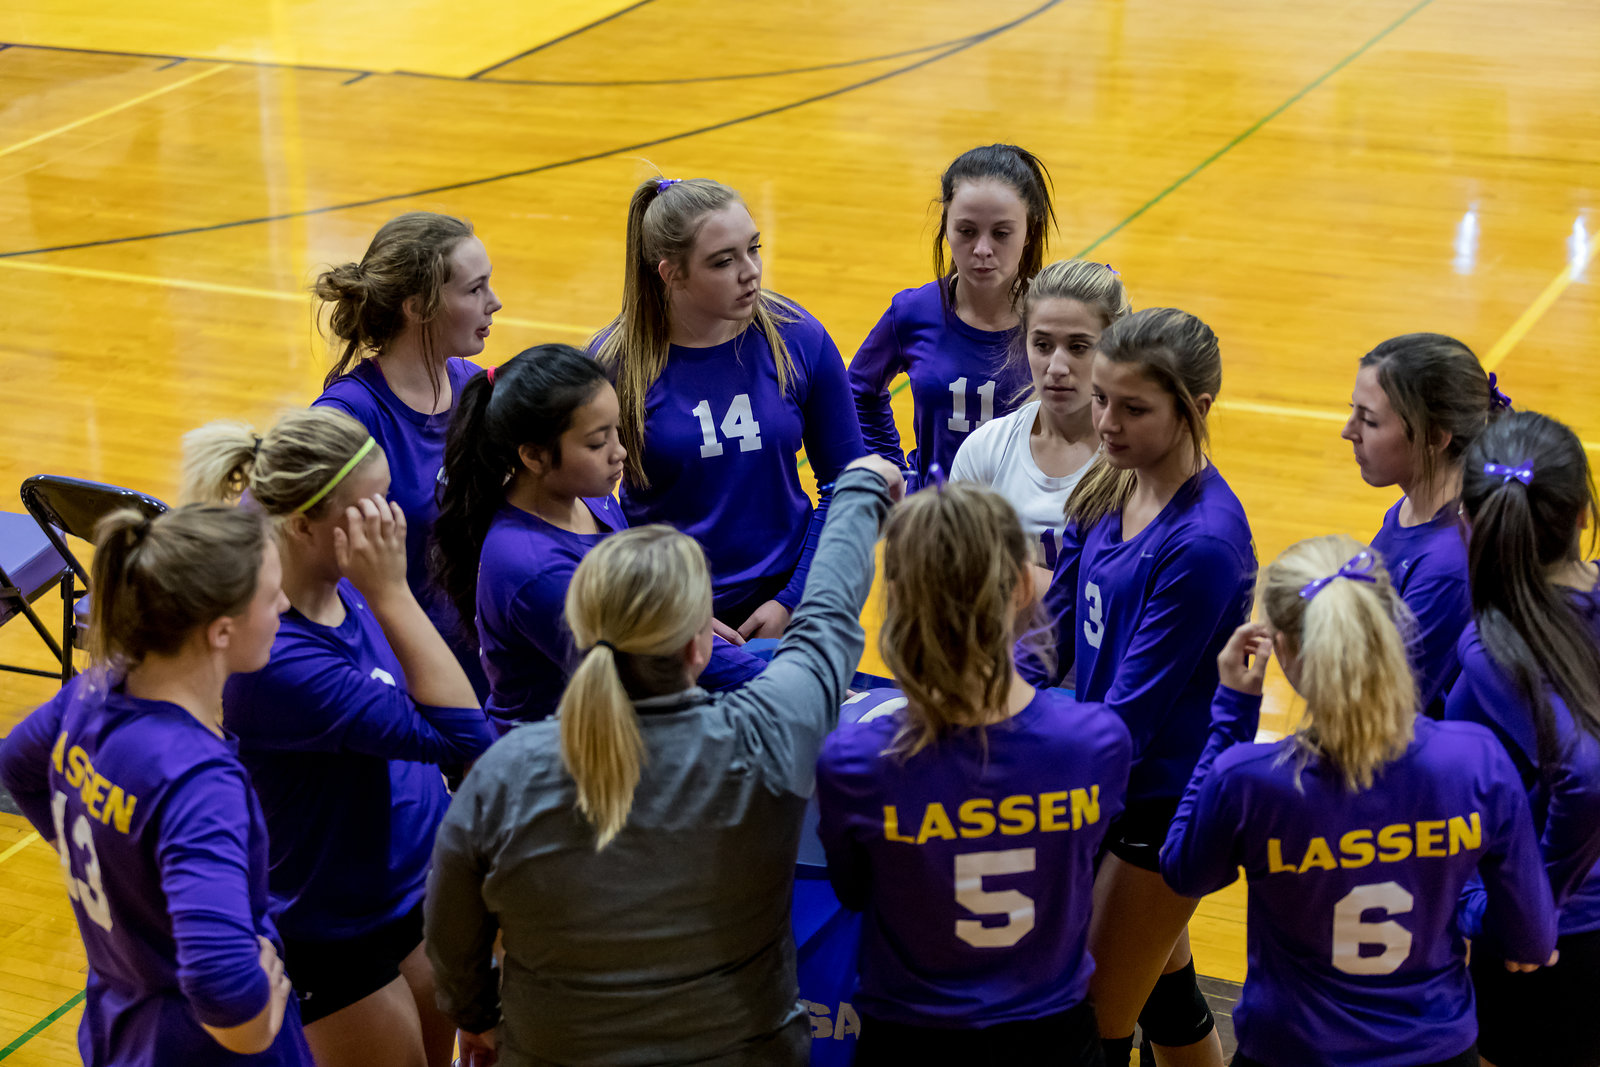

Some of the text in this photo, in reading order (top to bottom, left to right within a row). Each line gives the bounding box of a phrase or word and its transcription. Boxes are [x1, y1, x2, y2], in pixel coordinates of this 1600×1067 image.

[692, 393, 762, 458] 14
[948, 376, 996, 432] 11
[1083, 580, 1105, 650] 3
[883, 784, 1100, 845] LASSEN
[1267, 812, 1482, 874] LASSEN
[52, 789, 114, 933] 13
[954, 847, 1036, 948] 5
[1331, 881, 1414, 975] 6
